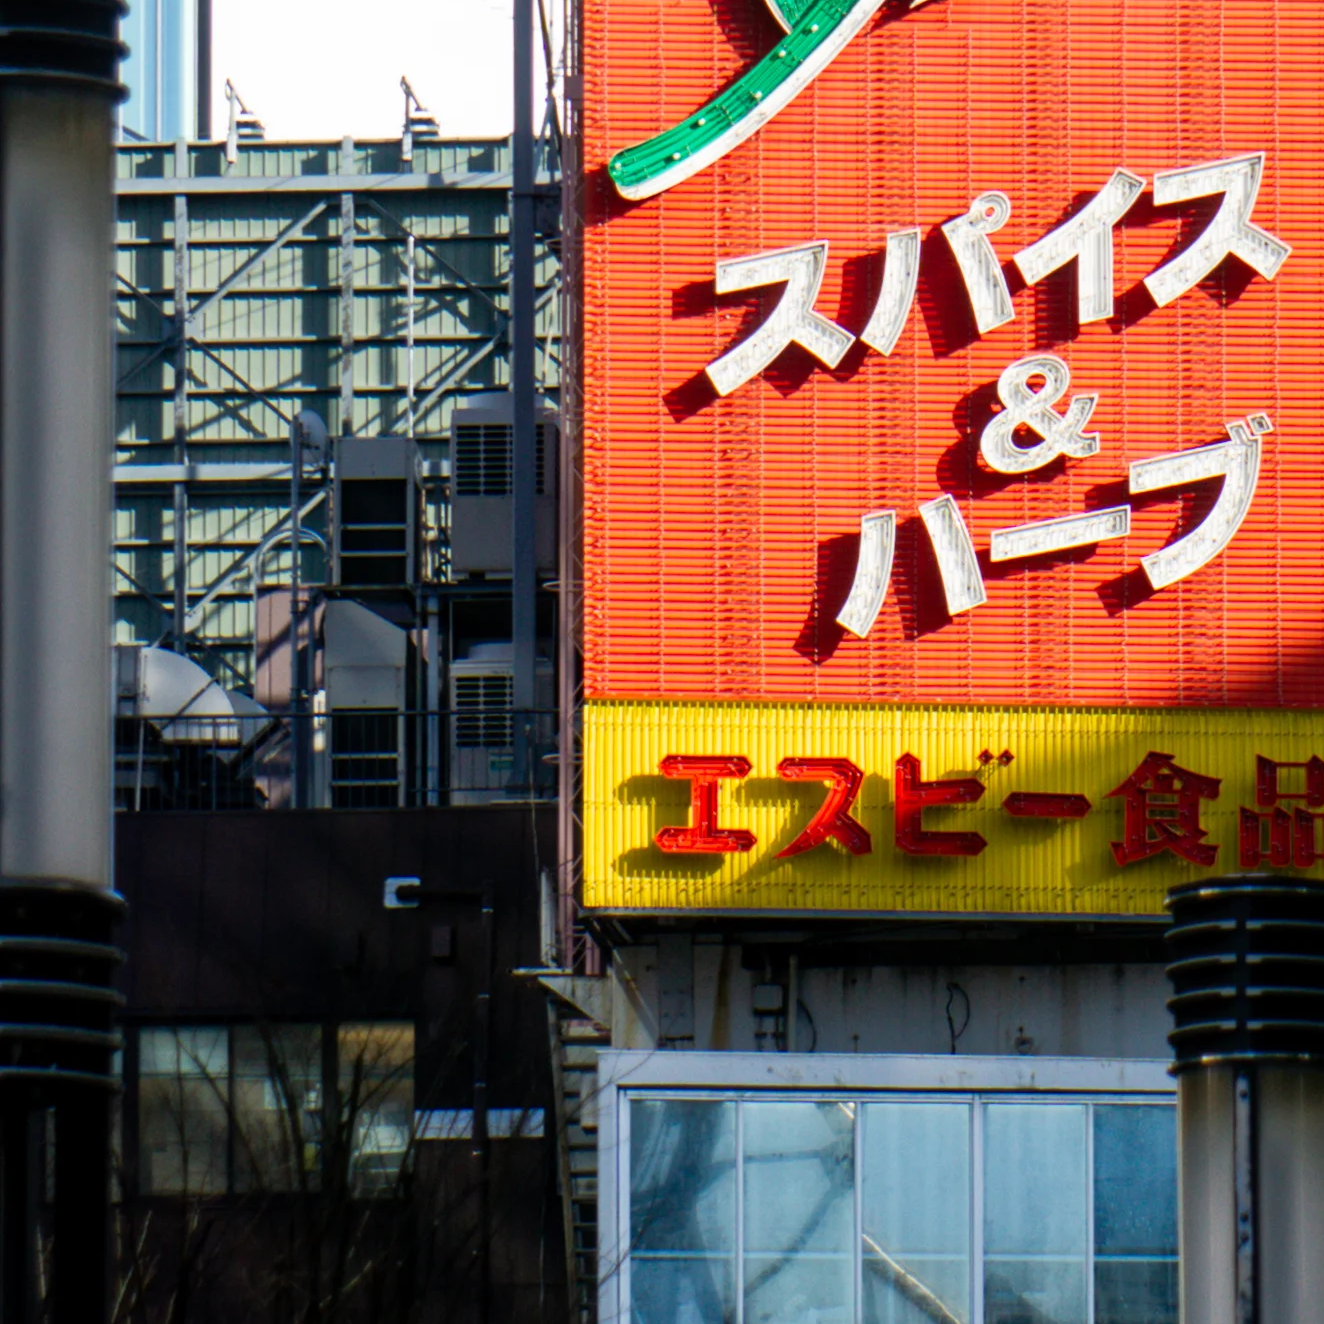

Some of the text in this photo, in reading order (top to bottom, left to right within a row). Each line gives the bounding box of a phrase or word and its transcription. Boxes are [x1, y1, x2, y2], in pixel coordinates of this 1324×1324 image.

[704, 151, 1293, 397] スパイス
[836, 411, 1274, 640] ハーブ
[981, 353, 1100, 475] &
